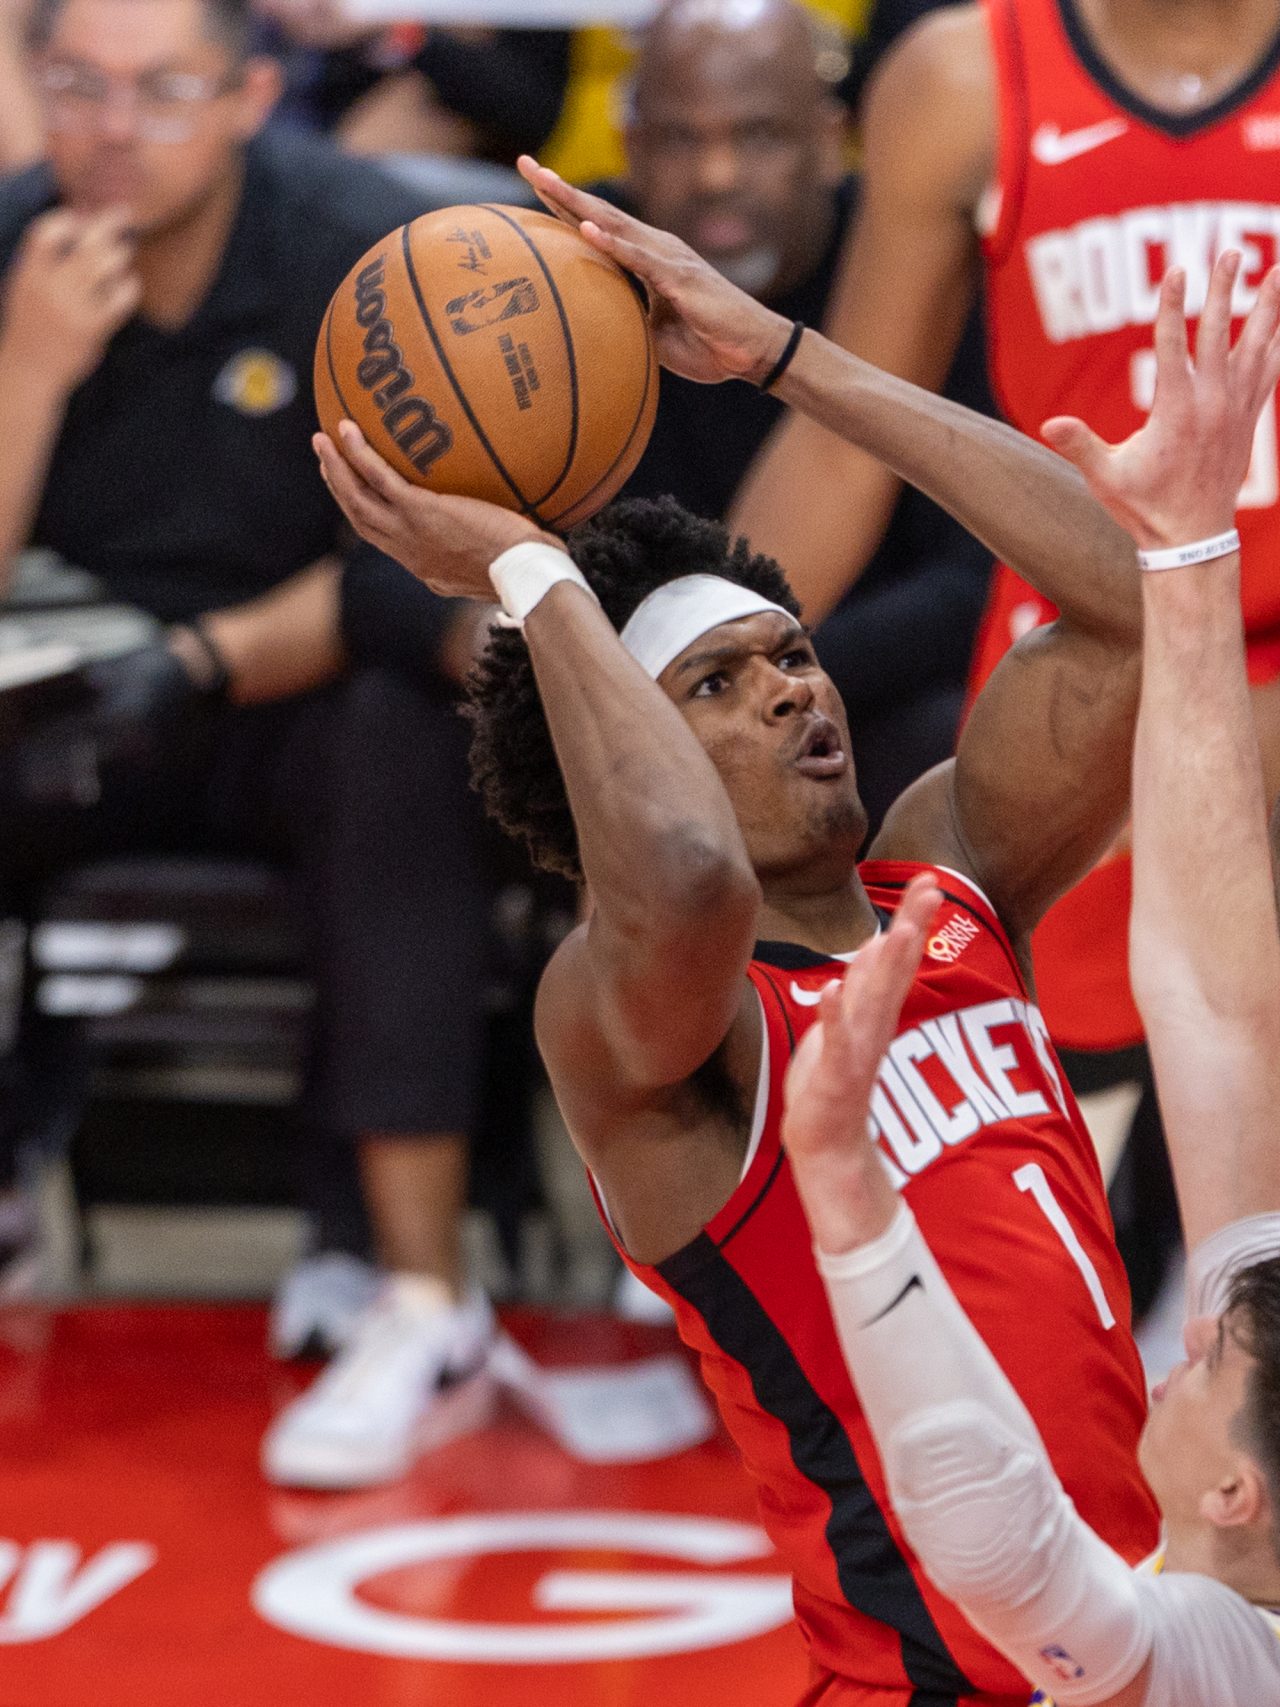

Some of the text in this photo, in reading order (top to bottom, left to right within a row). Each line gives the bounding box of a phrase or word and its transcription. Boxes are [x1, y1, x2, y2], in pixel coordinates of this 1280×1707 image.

[355, 254, 454, 478] Wilson
[867, 997, 1072, 1191] OCKE
[1013, 1162, 1116, 1331] 1
